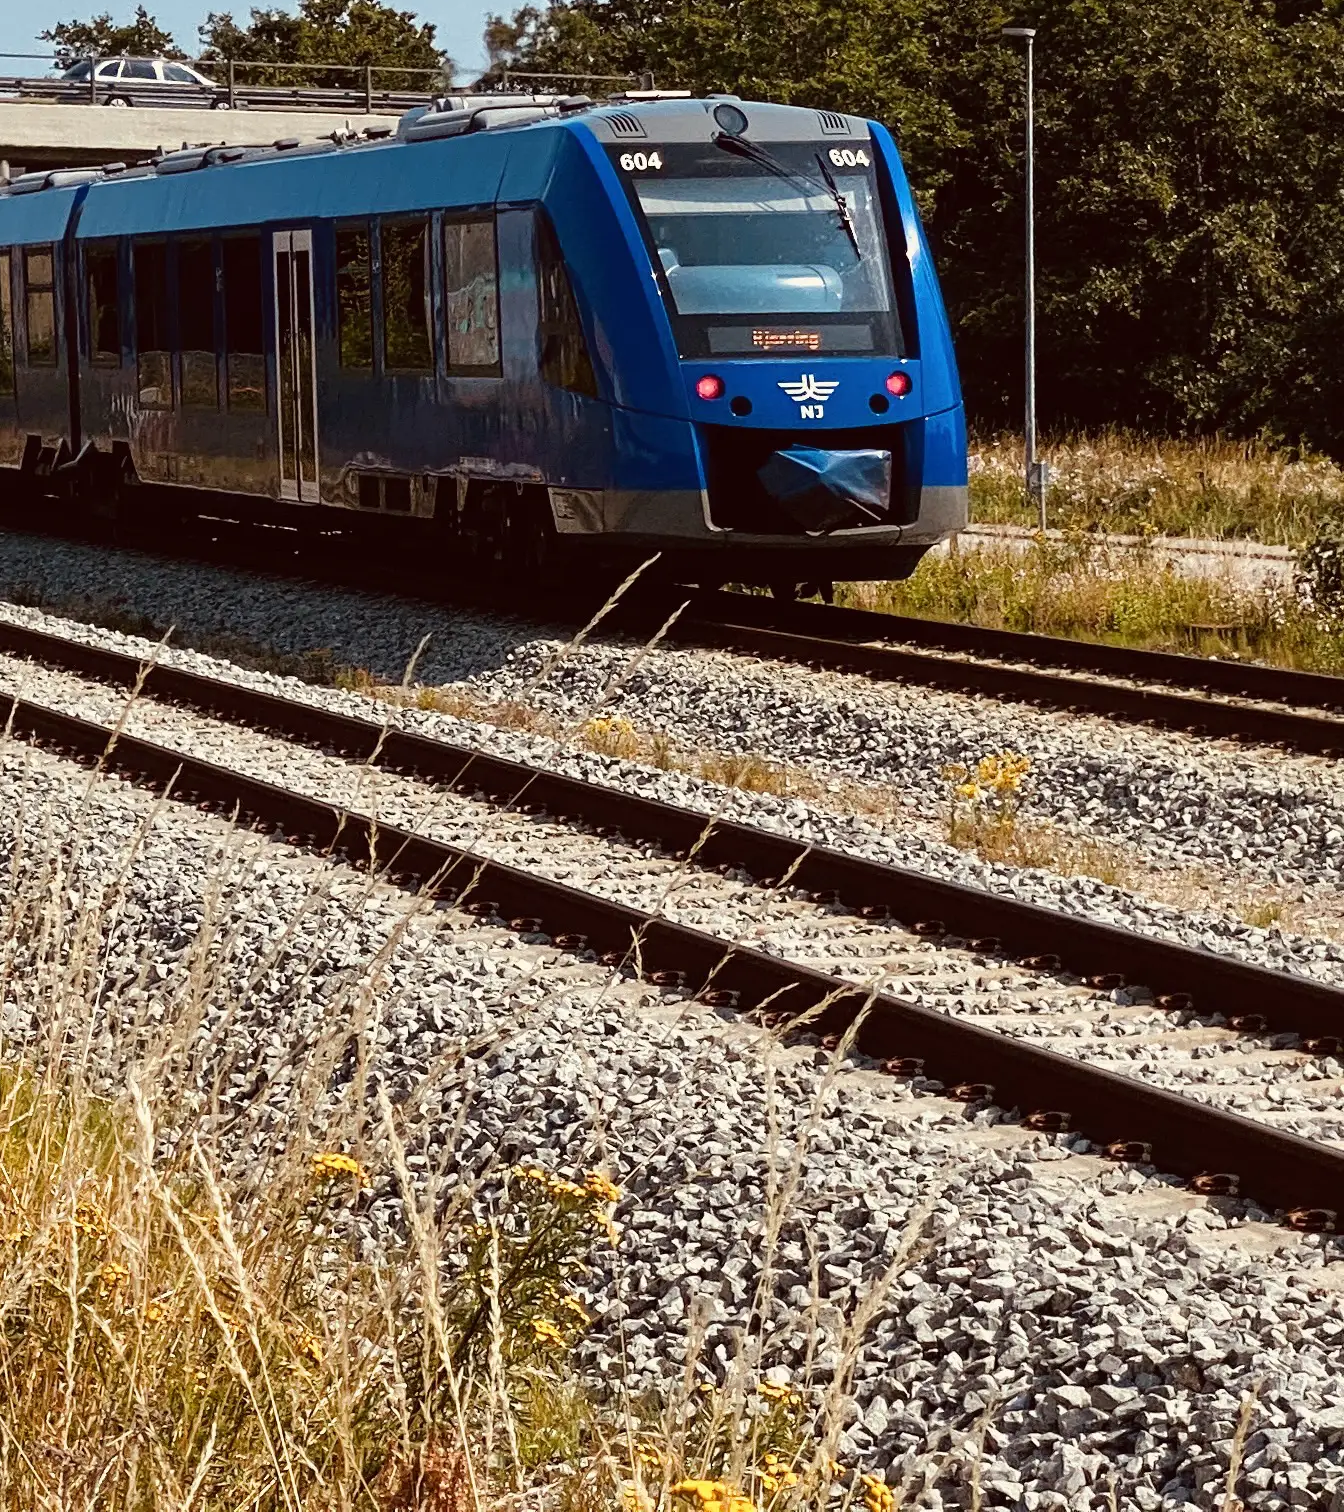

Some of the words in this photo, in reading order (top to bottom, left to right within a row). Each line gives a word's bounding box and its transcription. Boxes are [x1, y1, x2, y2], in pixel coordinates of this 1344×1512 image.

[619, 152, 663, 171] 604
[828, 148, 870, 167] 604
[800, 405, 824, 419] NJ
